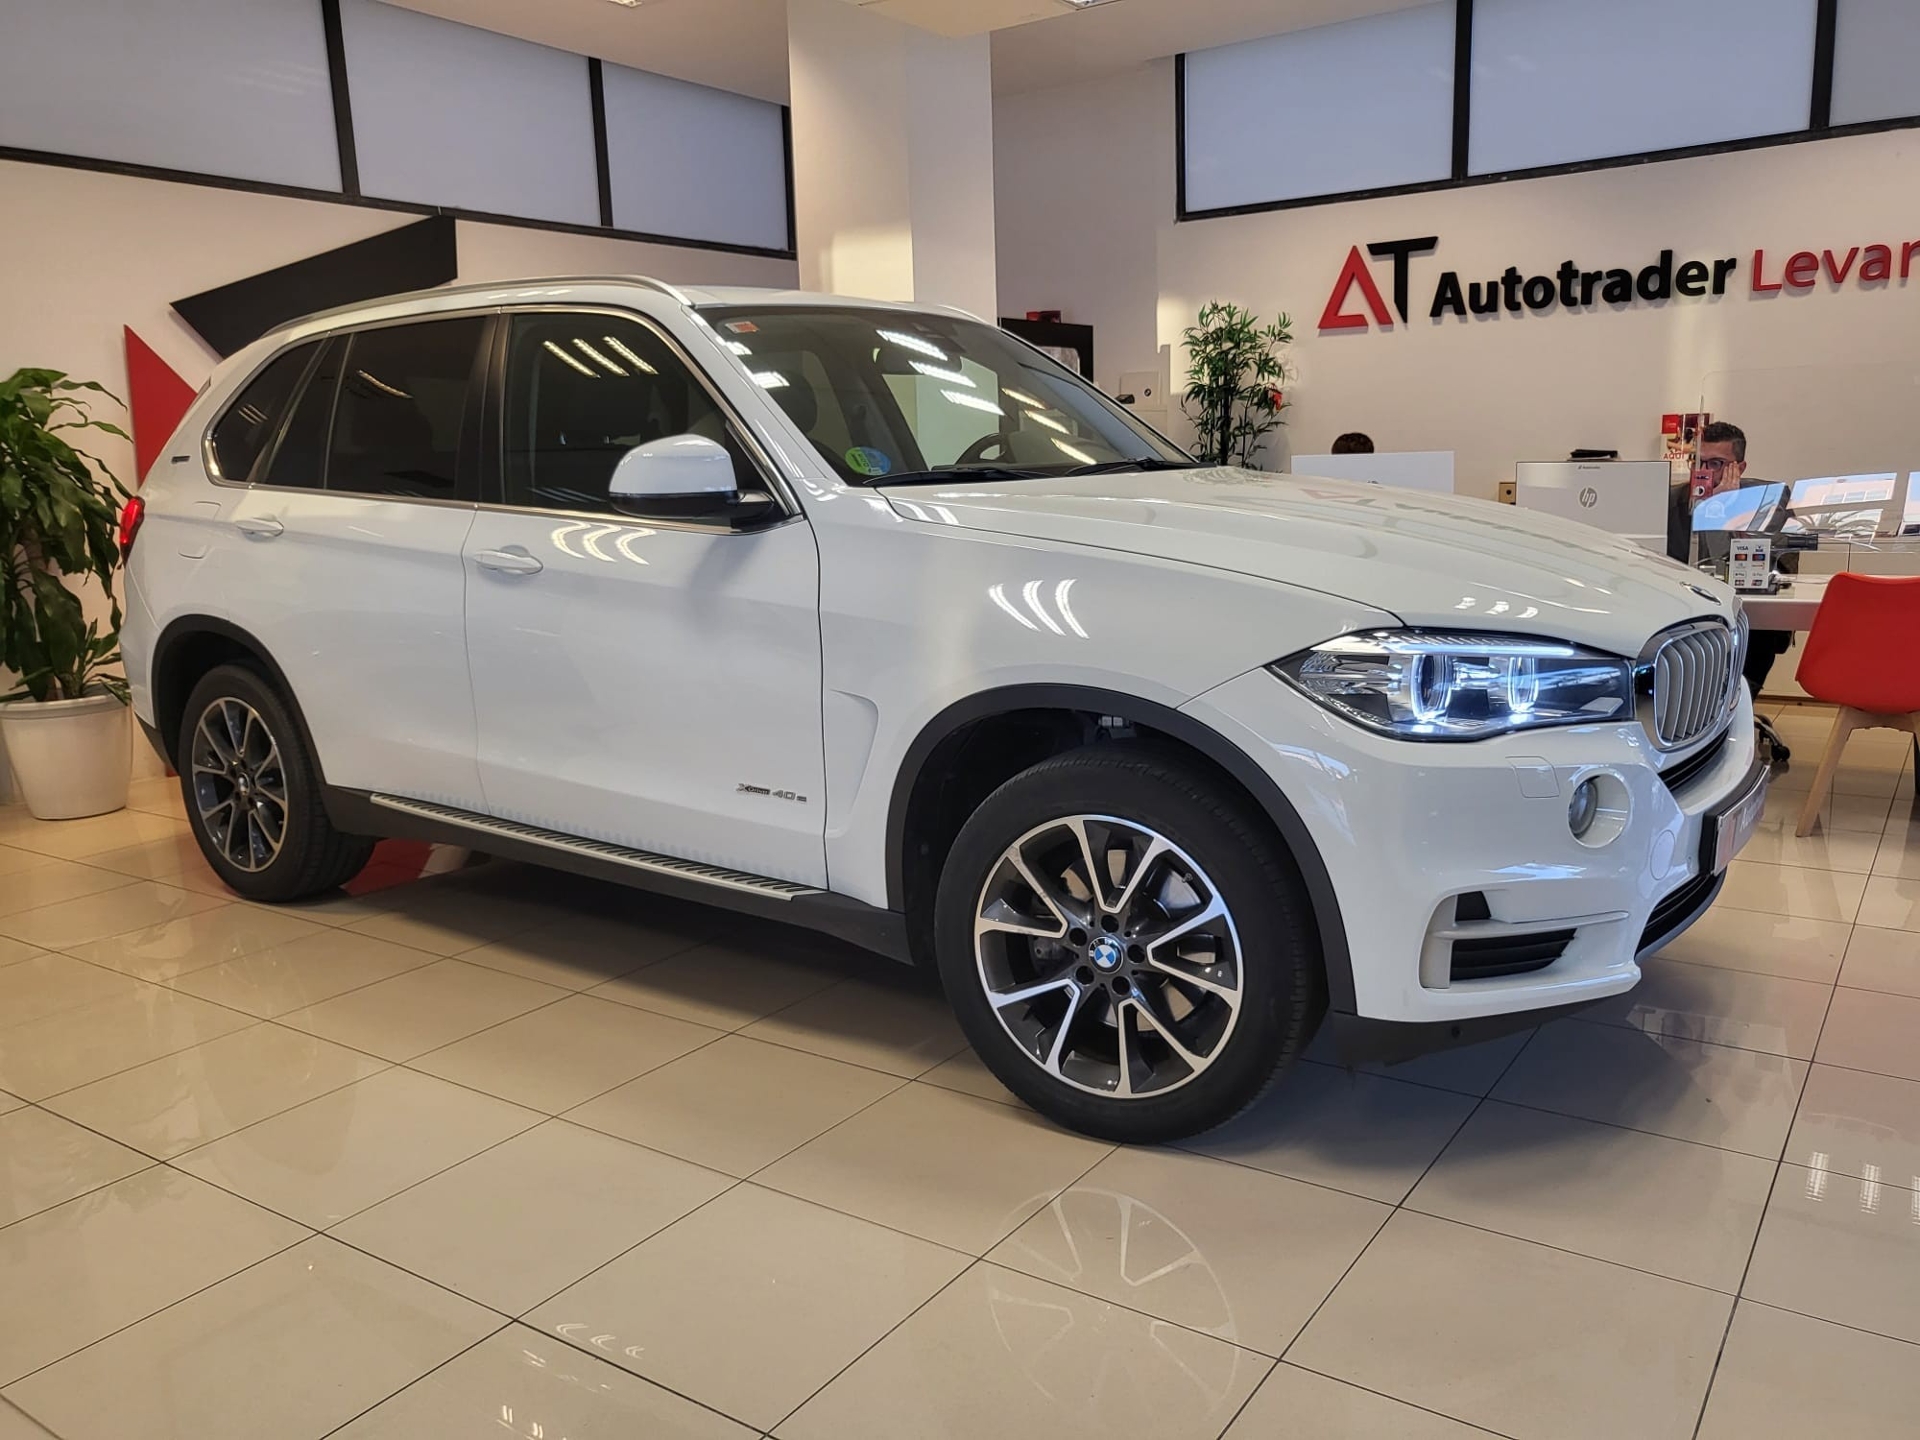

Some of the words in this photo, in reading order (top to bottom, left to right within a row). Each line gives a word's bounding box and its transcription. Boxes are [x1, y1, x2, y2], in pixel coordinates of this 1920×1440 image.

[1317, 236, 1439, 329] AT
[1429, 249, 1737, 318] Autotrader
[1580, 487, 1597, 508] hp
